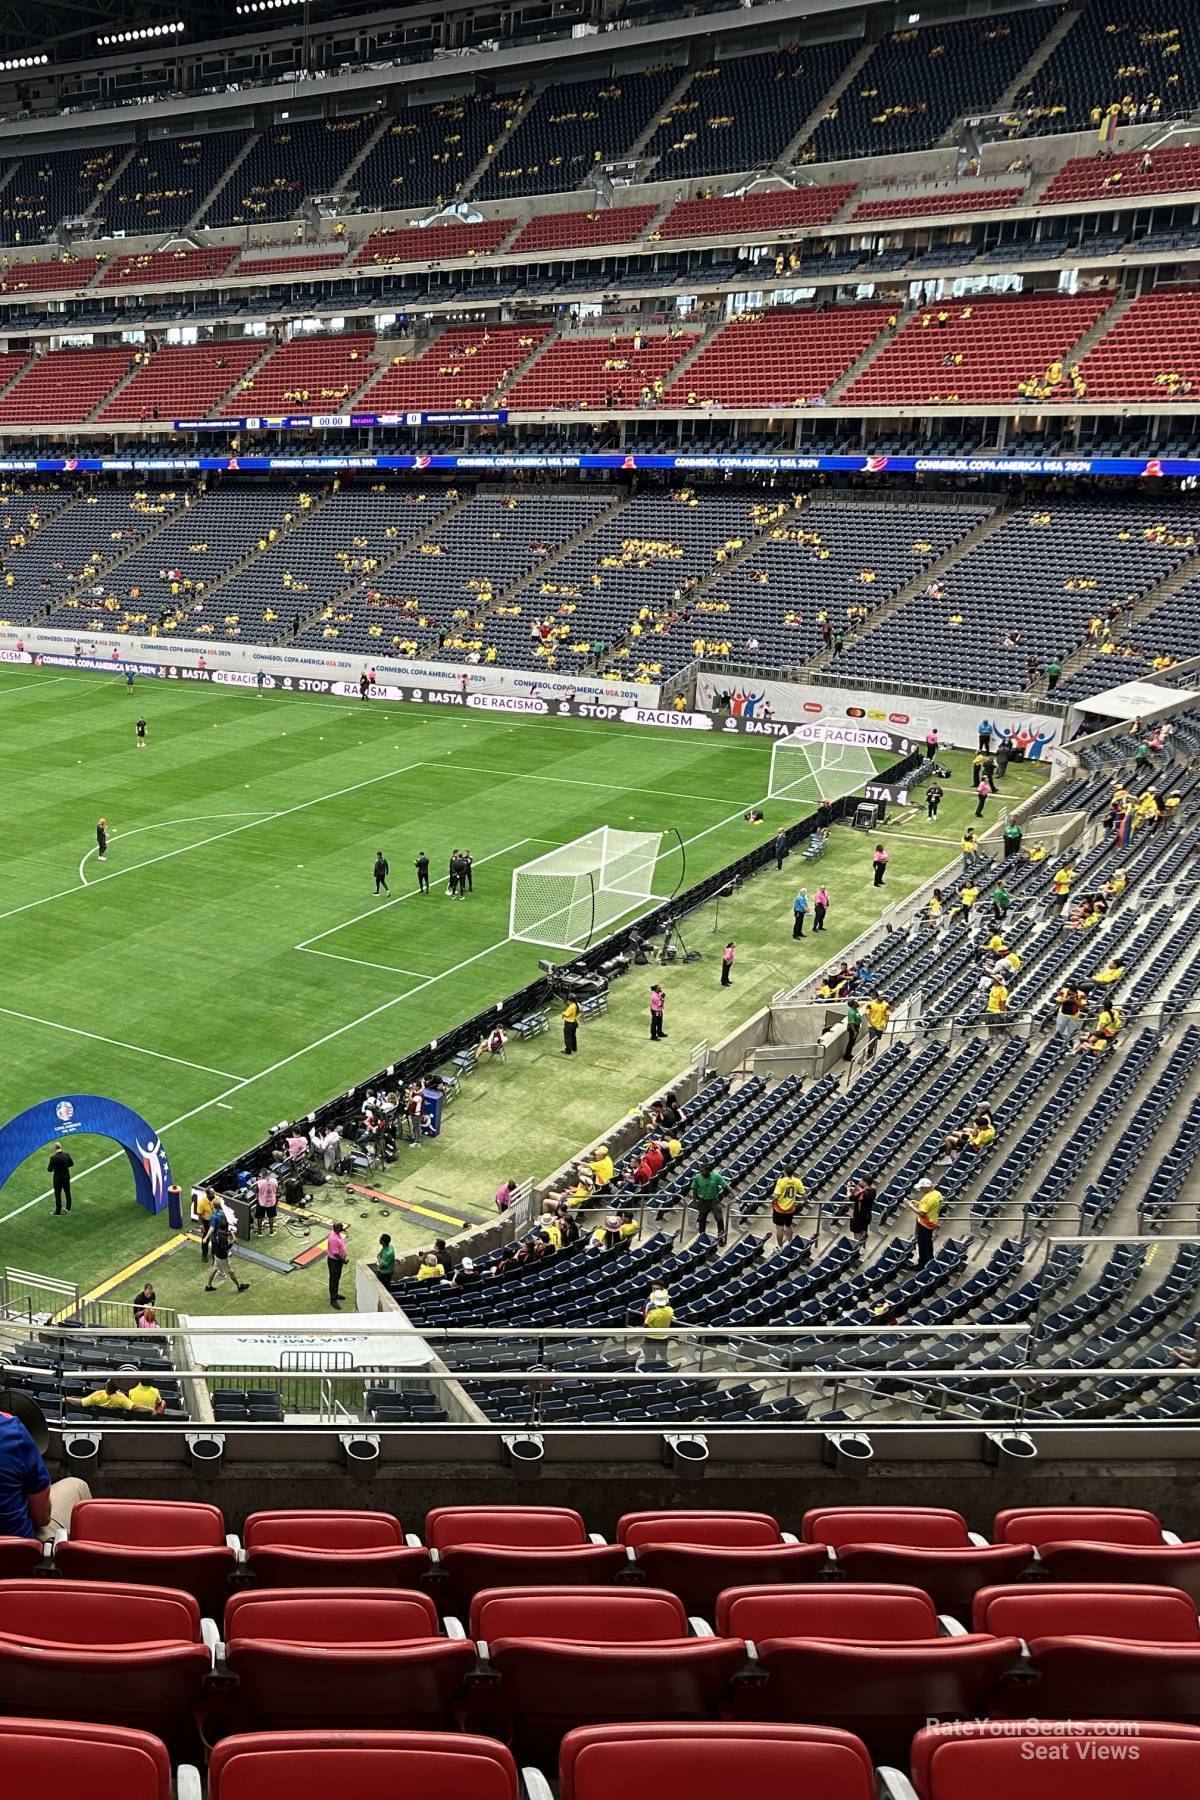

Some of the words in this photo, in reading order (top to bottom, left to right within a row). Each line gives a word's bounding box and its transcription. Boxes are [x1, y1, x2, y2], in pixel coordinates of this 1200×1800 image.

[720, 458, 741, 468] COPA
[741, 458, 779, 468] AMERICA
[969, 460, 995, 471] COPA
[995, 460, 1041, 471] AMERICA
[141, 643, 168, 651] CONMEBOL
[183, 647, 206, 655] AMERICA
[42, 655, 76, 667] CONMEBOL
[77, 659, 93, 668] COPA
[92, 660, 124, 671] AMERICA
[253, 653, 282, 661] CONMEBOL
[300, 657, 325, 666] AMERICA
[182, 669, 209, 681] BASTA
[217, 673, 227, 682] DE
[231, 674, 271, 686] RACISO
[376, 665, 409, 675] CONMEBOL
[411, 668, 427, 676] COPA
[428, 670, 456, 679] AMERICA
[470, 674, 486, 683] 2024
[299, 680, 329, 692] STOP
[344, 683, 387, 697] RAISM
[513, 679, 551, 690] CONMEBOL
[605, 688, 618, 697] USA
[620, 690, 638, 699] 2024
[428, 692, 463, 704] BASTA
[473, 697, 487, 706] DE
[491, 698, 543, 711] RACISMO
[579, 705, 617, 719] STOP
[637, 711, 692, 726] RACISM
[746, 721, 788, 735] BASTA
[803, 728, 821, 739] DE
[825, 730, 888, 746] RACISMO
